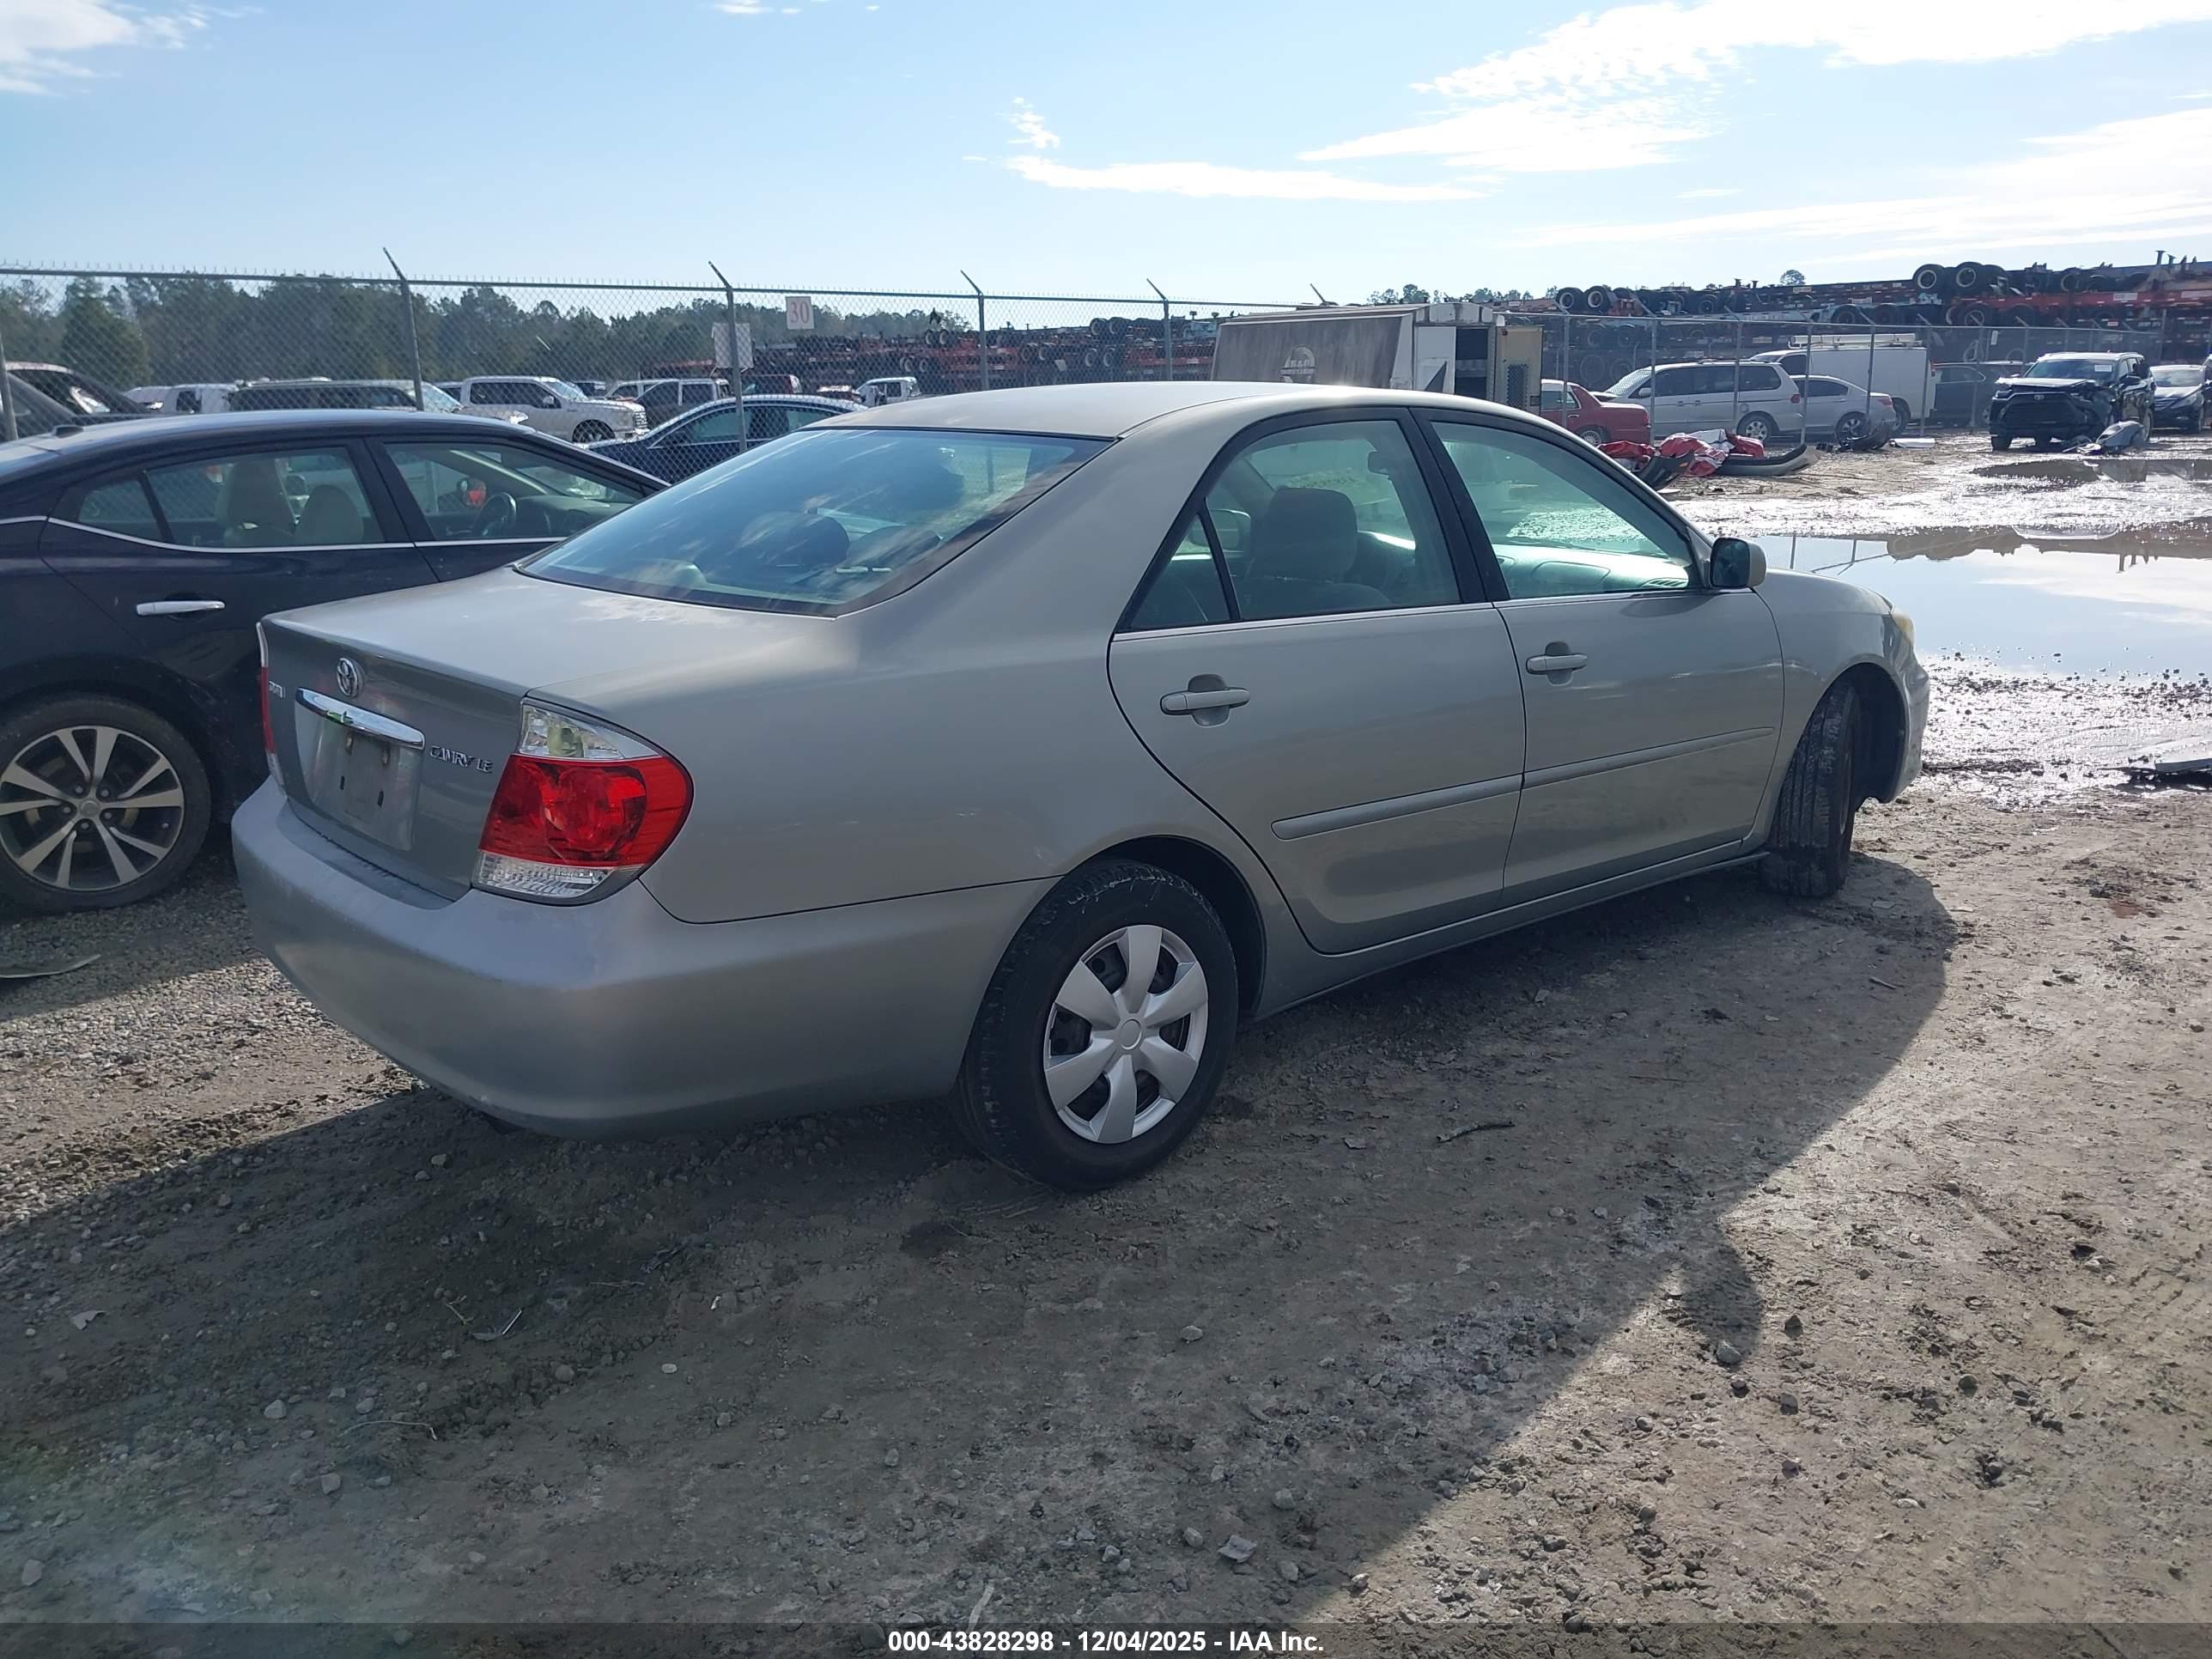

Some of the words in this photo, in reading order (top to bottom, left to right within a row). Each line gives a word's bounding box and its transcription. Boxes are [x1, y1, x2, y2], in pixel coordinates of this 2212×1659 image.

[790, 301, 810, 324] 30
[430, 745, 475, 767] CAMRY
[477, 758, 493, 773] LE
